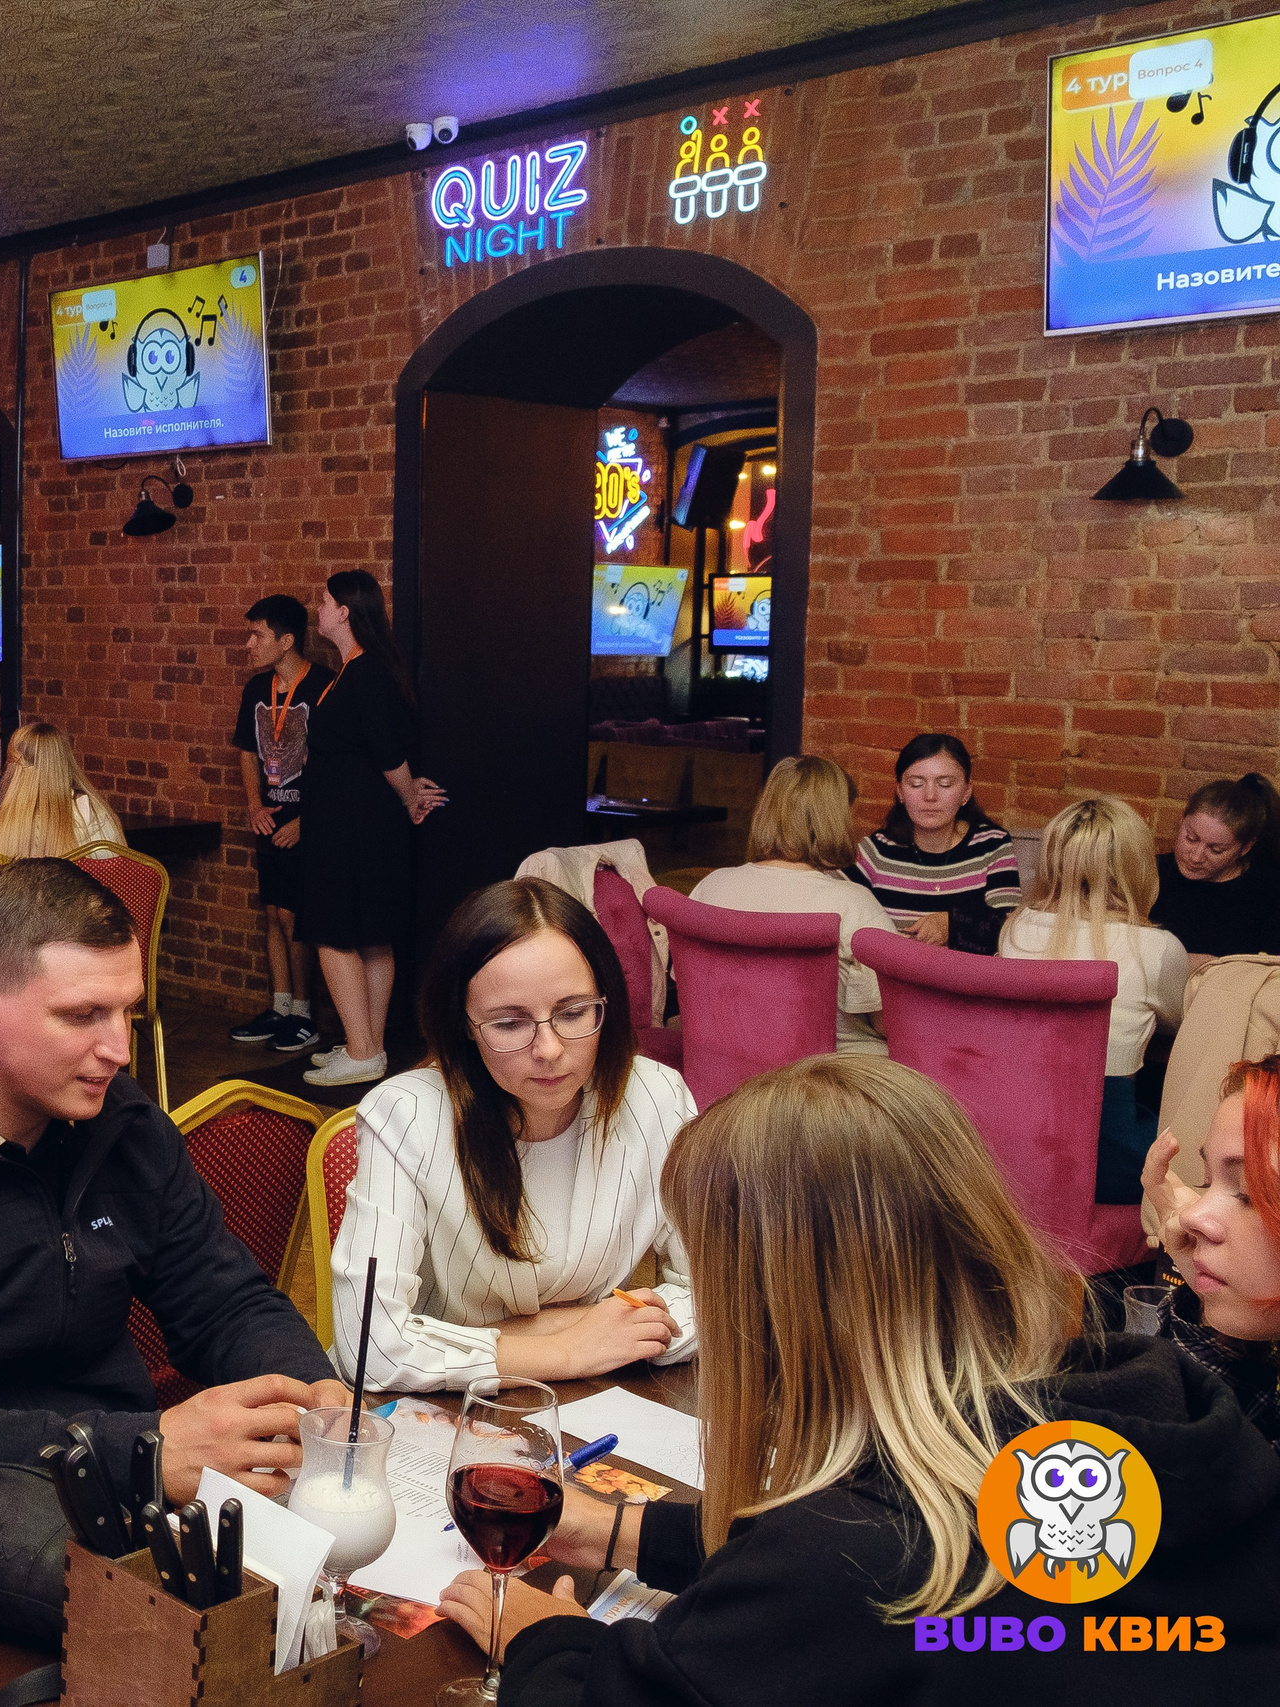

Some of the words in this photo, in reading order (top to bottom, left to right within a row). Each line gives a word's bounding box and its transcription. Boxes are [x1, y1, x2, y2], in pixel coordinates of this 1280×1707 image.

[1137, 60, 1191, 81] Вопрос
[1194, 58, 1204, 70] 4
[1065, 76, 1081, 95] 4
[1087, 69, 1129, 96] тур
[431, 140, 588, 229] QUIZ
[445, 210, 575, 268] NIGHT
[239, 269, 248, 283] 4
[1156, 261, 1280, 292] Назовите
[56, 305, 64, 317] 4
[65, 303, 83, 318] тур
[103, 424, 153, 439] Назовите
[155, 418, 224, 434] исполнителя.
